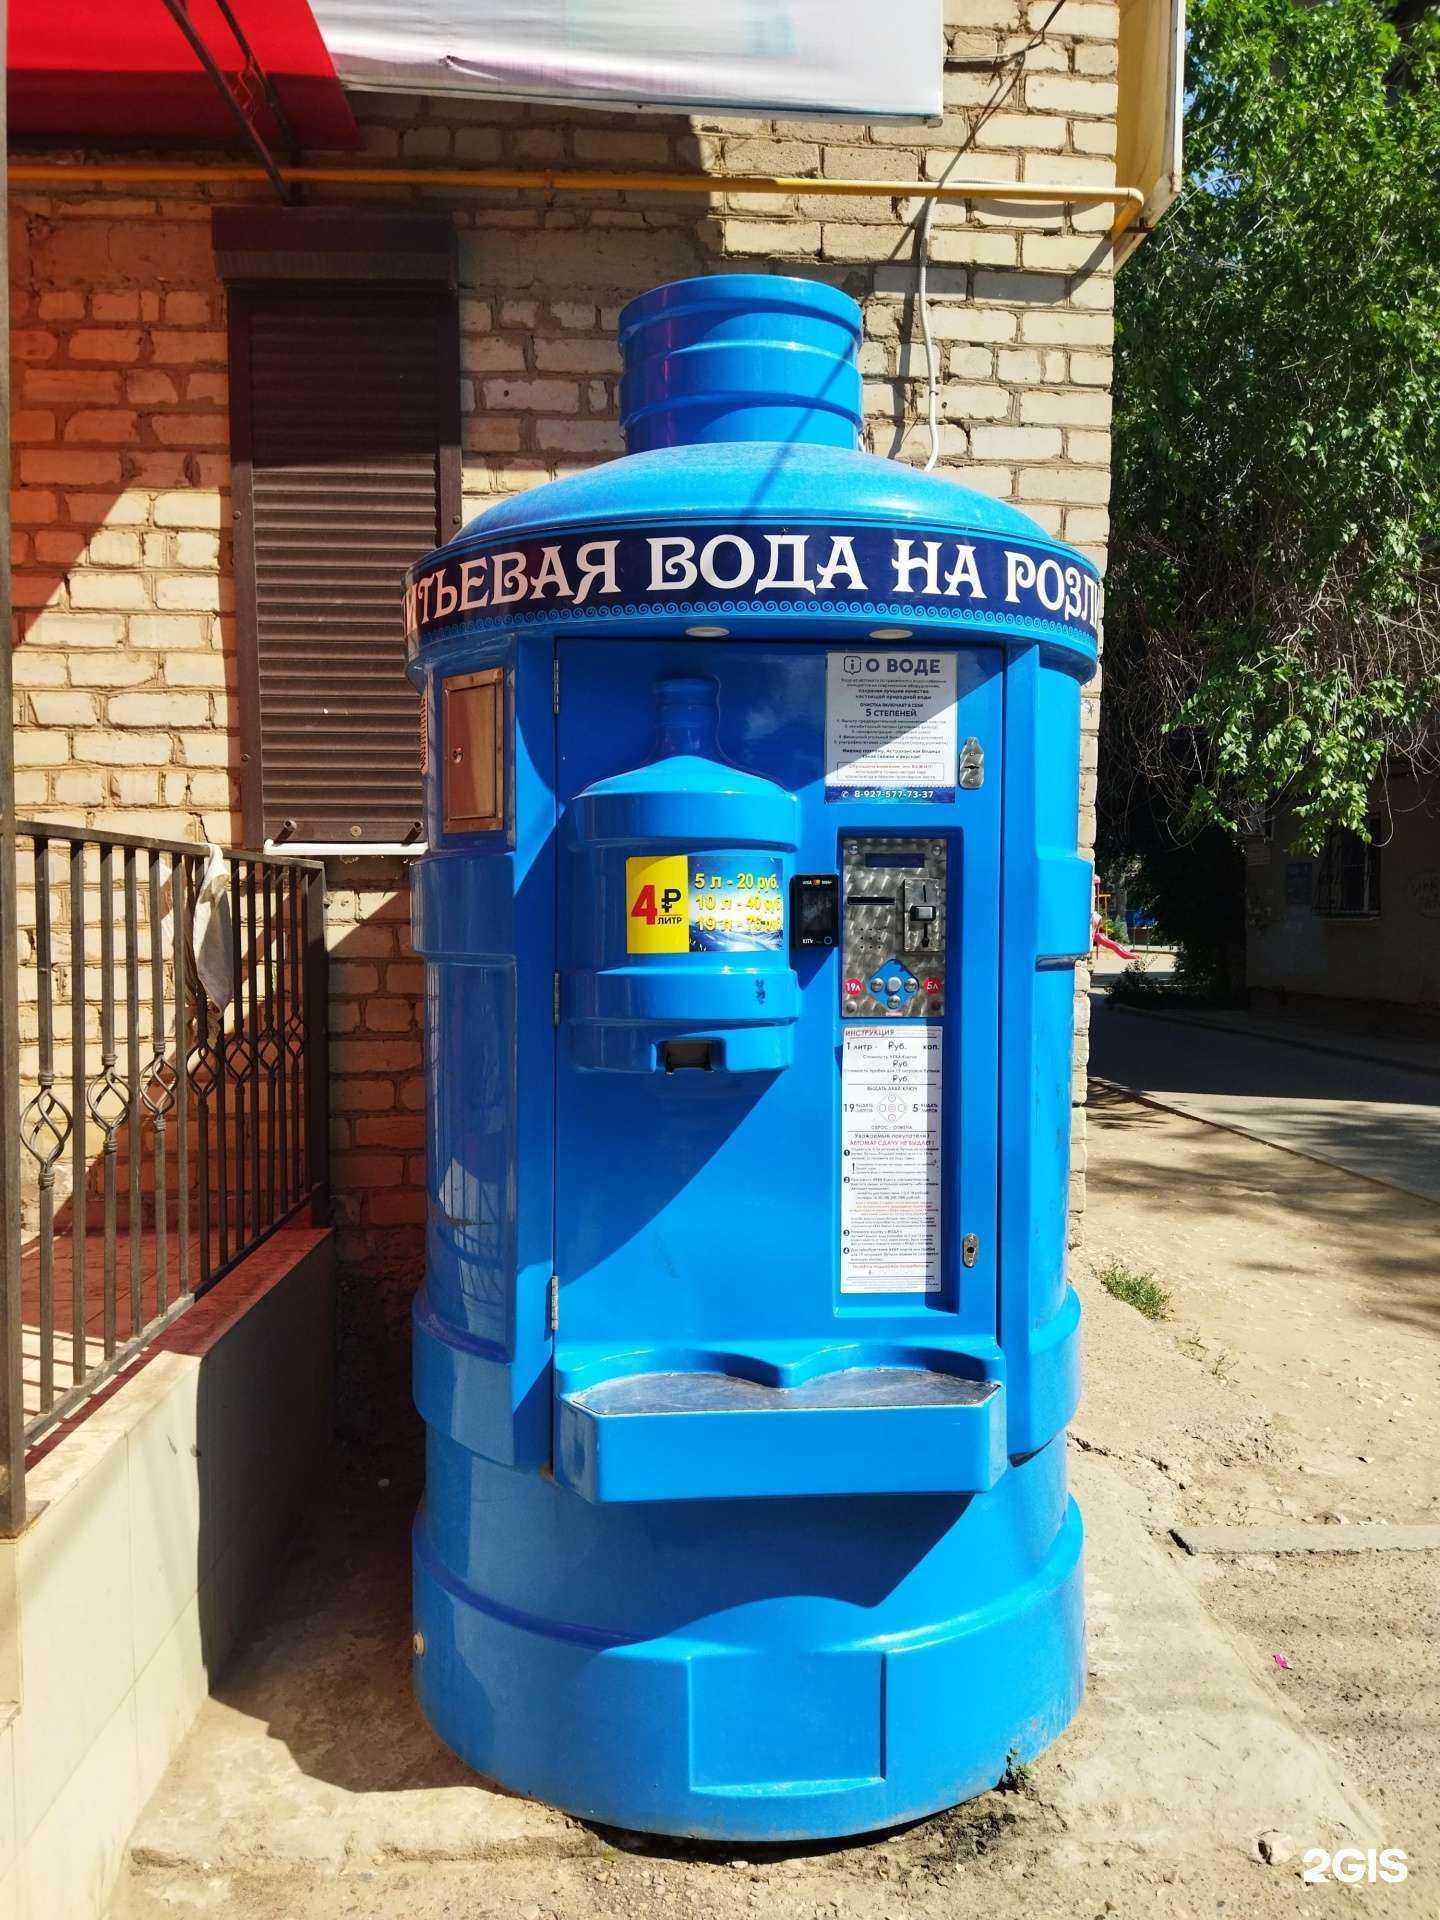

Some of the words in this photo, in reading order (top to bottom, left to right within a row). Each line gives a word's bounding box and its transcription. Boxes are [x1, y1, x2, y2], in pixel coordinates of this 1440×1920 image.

[645, 534, 872, 595] ВОДА
[891, 541, 987, 599] НА
[1003, 551, 1097, 629] РОЗЛ
[865, 658, 880, 673] О
[887, 658, 941, 676] ВОДЕ
[865, 708, 872, 717] 5
[873, 708, 917, 717] СТЕПЕНЕЙ
[854, 790, 934, 799] 8-927-577-73-37
[694, 873, 705, 890] 5
[737, 872, 754, 889] 20
[695, 894, 716, 911] 10
[657, 916, 682, 925] ЛИТР
[845, 1028, 895, 1037] ИНСТРУКЦИЯ
[912, 1103, 919, 1113] 5
